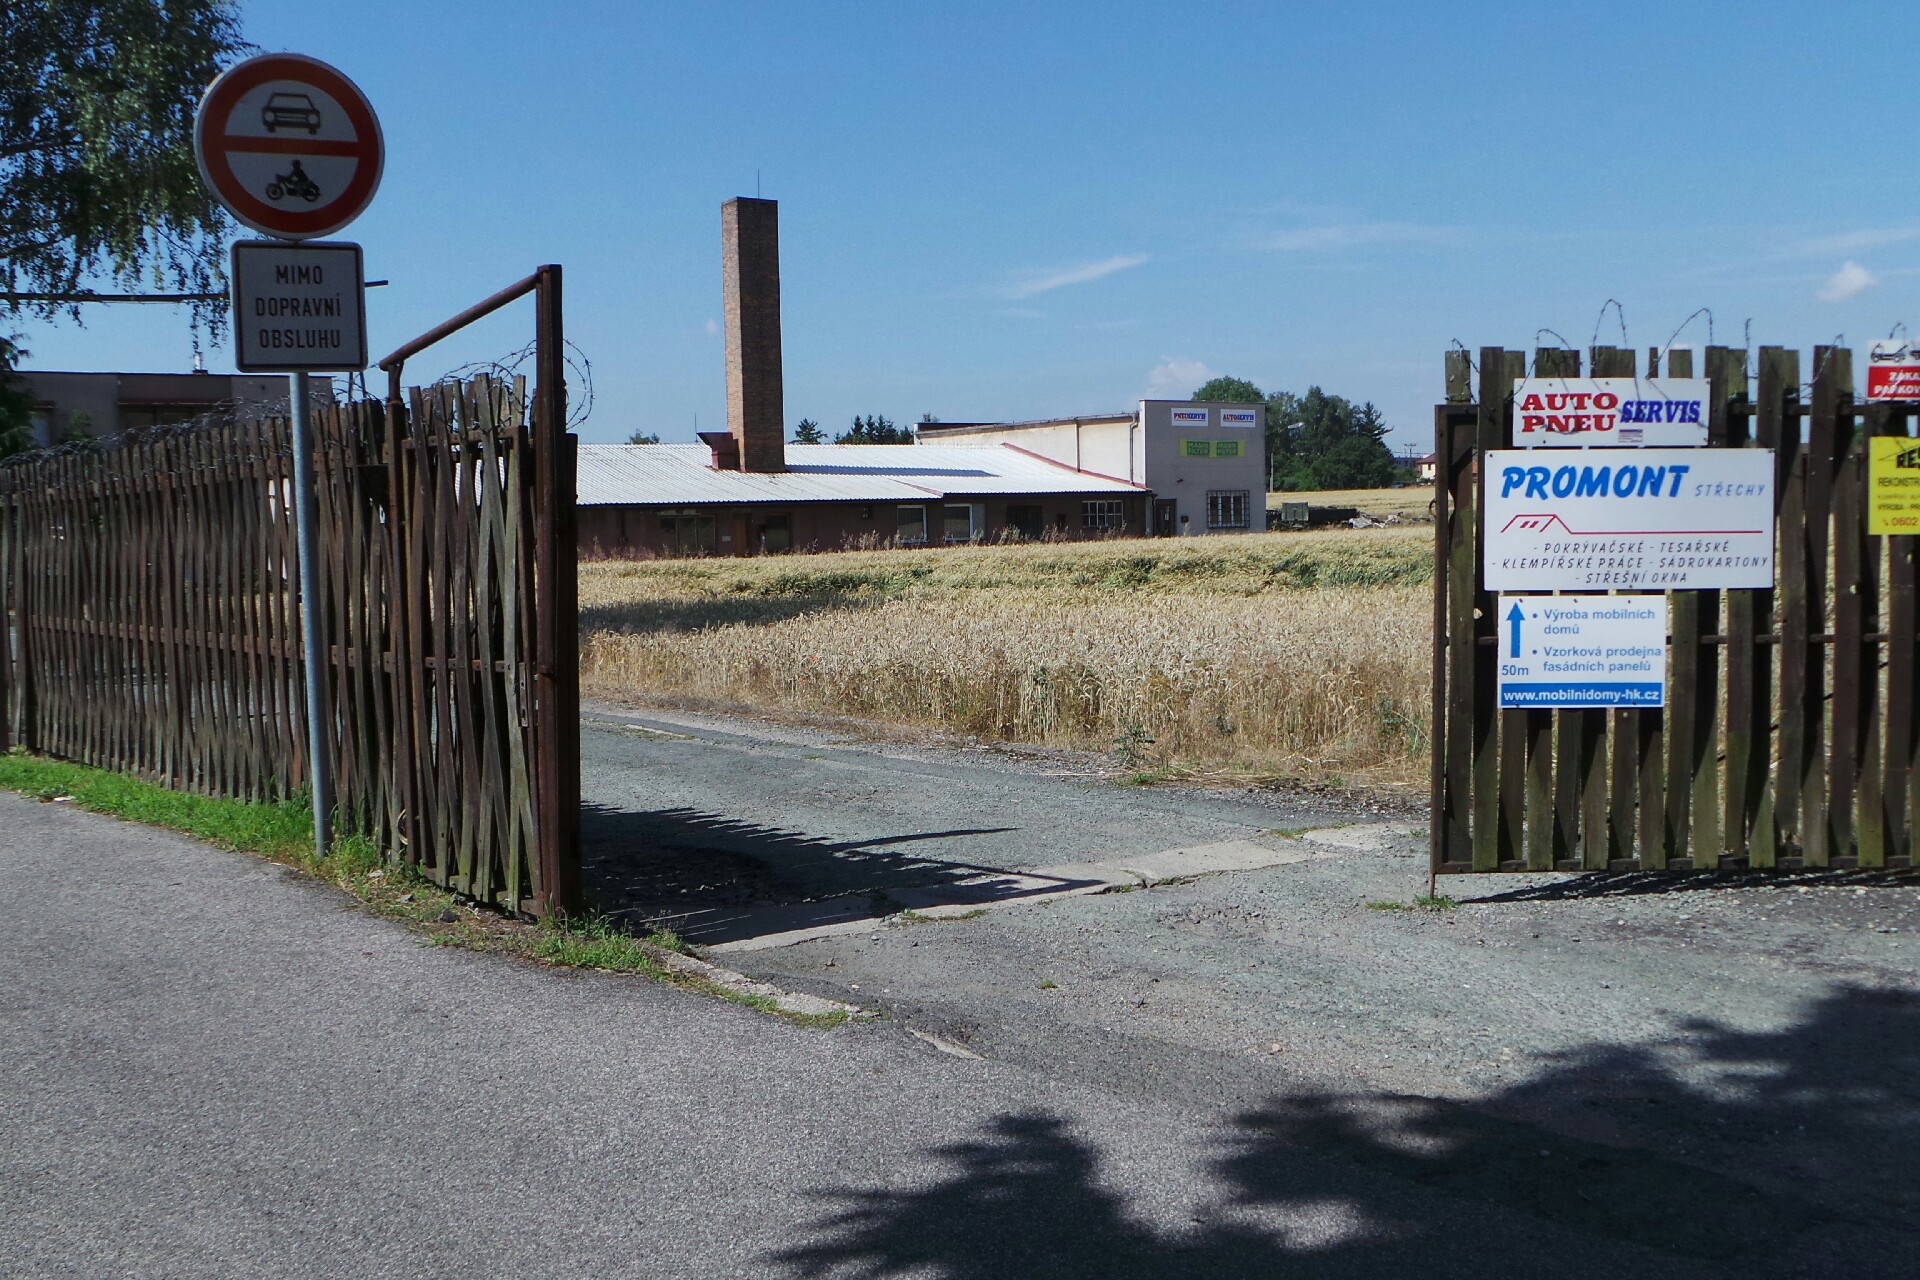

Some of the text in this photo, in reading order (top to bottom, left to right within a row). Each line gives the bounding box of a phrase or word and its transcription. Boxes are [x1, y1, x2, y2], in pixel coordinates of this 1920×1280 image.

[275, 264, 323, 285] MIMO
[255, 292, 341, 317] DOPRAVNÍ
[259, 328, 341, 349] OBSLUHU
[1520, 393, 1619, 411] AUTO
[1619, 400, 1701, 424] SERVIS
[1522, 414, 1616, 433] PNEU
[1501, 465, 1766, 500] PROMONT STŘECHY
[1543, 539, 1729, 554] POKRÝVAČSKÉ TESAŘSKÉ
[1502, 555, 1768, 569] KLEMPÍŘSKÉ PRÁCE SÁDROKARTONY
[1586, 570, 1687, 584] STŘEŠNÍ OKNA
[1543, 609, 1655, 622] Výroba mobilních
[1543, 646, 1662, 659] Vzorková prodejna
[1501, 664, 1529, 676] 50m
[1543, 661, 1604, 672] fasádních
[1503, 688, 1659, 703] www.mobilnidomy-hk.cz
